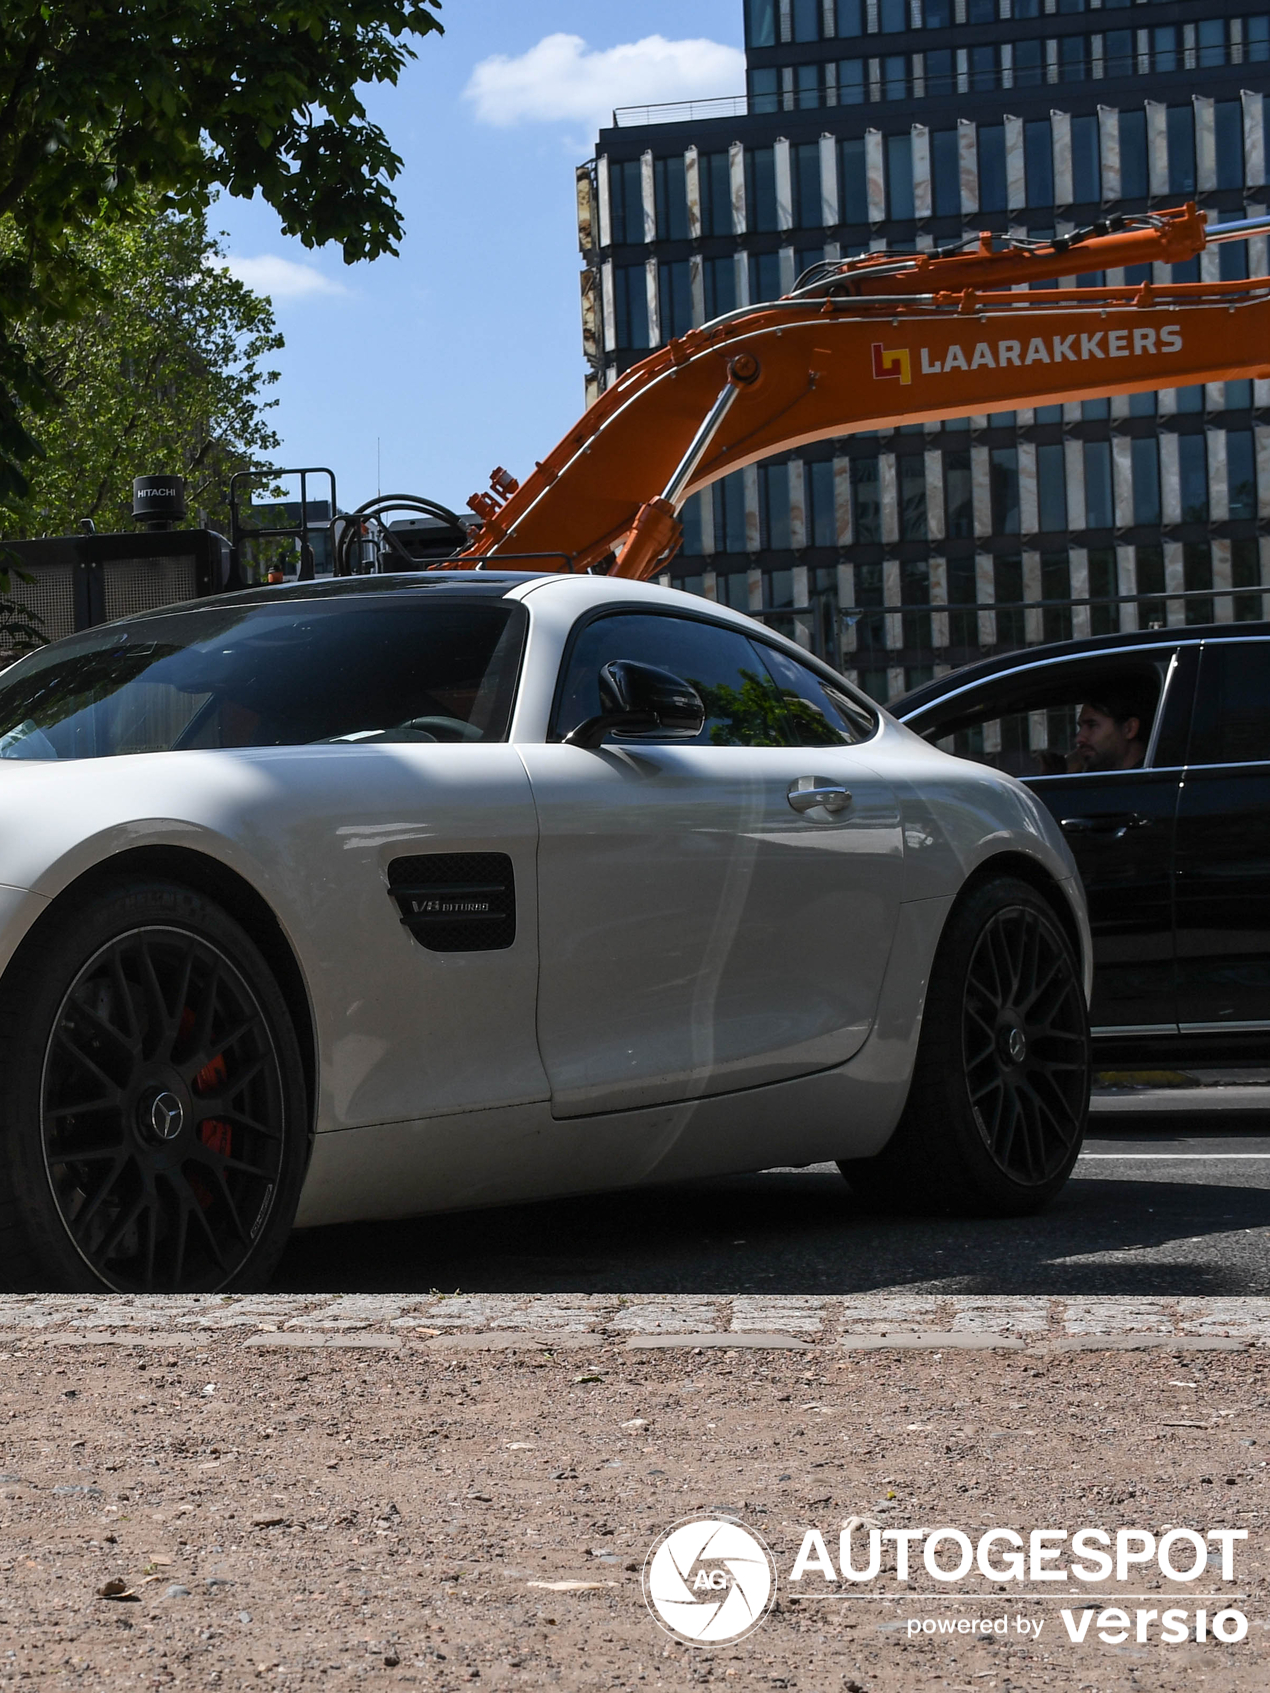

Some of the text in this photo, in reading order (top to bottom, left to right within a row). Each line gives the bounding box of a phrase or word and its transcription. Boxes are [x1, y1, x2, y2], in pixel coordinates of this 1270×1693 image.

[920, 325, 1183, 375] LAARAKKERS
[137, 489, 176, 498] HITACHI
[411, 900, 489, 912] V8 BITURBO
